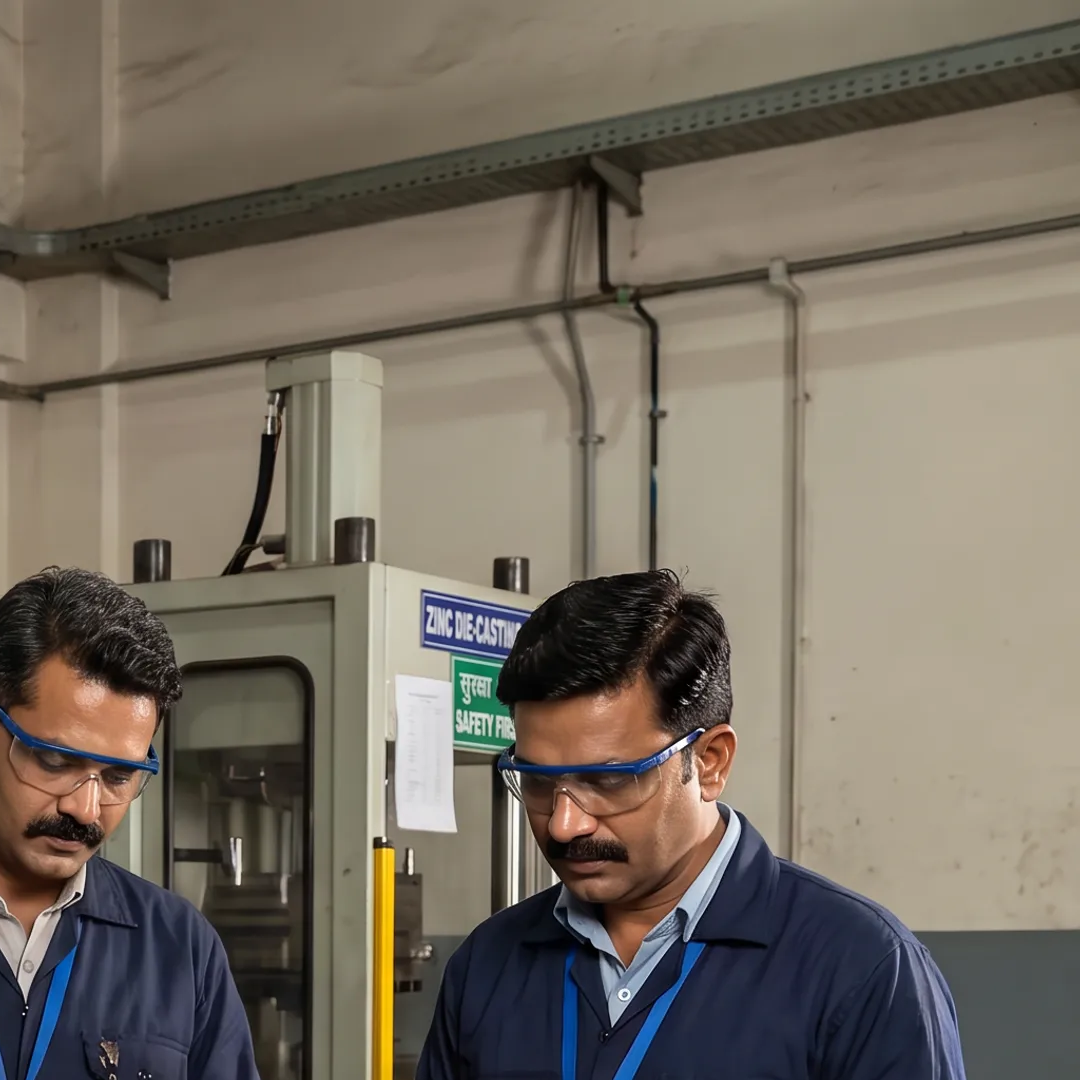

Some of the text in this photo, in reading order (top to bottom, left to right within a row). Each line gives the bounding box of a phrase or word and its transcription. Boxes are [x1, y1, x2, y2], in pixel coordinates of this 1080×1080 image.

[425, 604, 454, 639] ZINC
[455, 708, 517, 741] SAFETY FIRS
